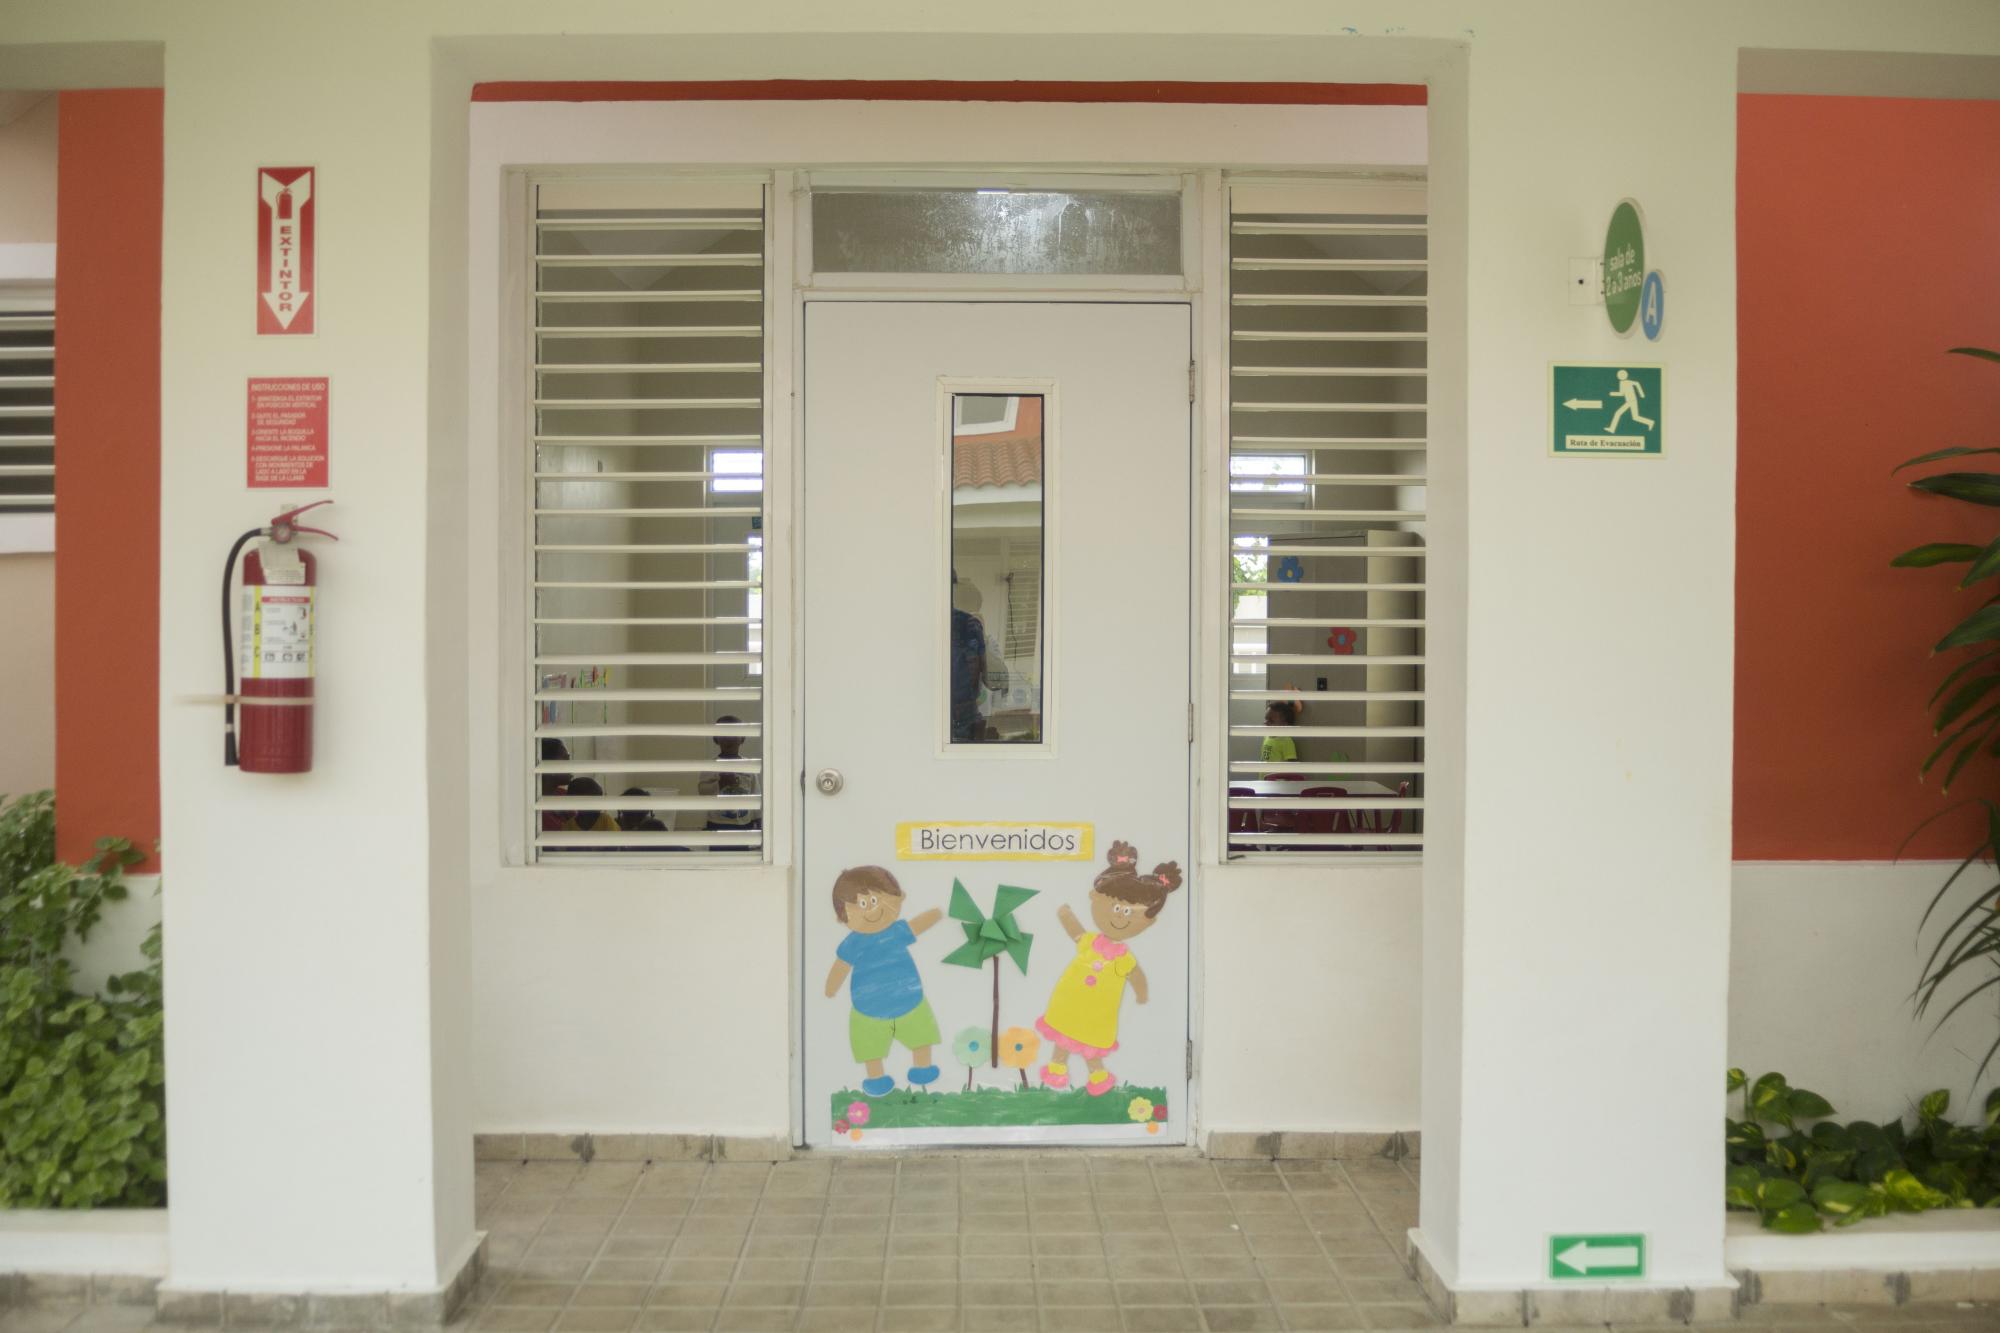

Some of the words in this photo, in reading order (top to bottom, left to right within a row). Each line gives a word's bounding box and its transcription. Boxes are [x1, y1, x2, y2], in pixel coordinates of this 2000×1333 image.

[278, 225, 293, 312] EXTINTOR
[1610, 247, 1625, 271] sala
[1625, 243, 1635, 265] de
[1606, 276, 1611, 297] 2
[1612, 281, 1617, 295] a
[1618, 271, 1623, 292] 3
[1624, 268, 1642, 290] años
[1645, 281, 1657, 326] A
[251, 383, 301, 391] INSTRUCCIONES
[302, 383, 310, 391] DE
[311, 383, 326, 391] USO
[1570, 439, 1588, 447] Ruta
[1589, 439, 1599, 447] de
[1600, 439, 1641, 448] Evacuación
[921, 828, 1075, 851] Bienvenidos
